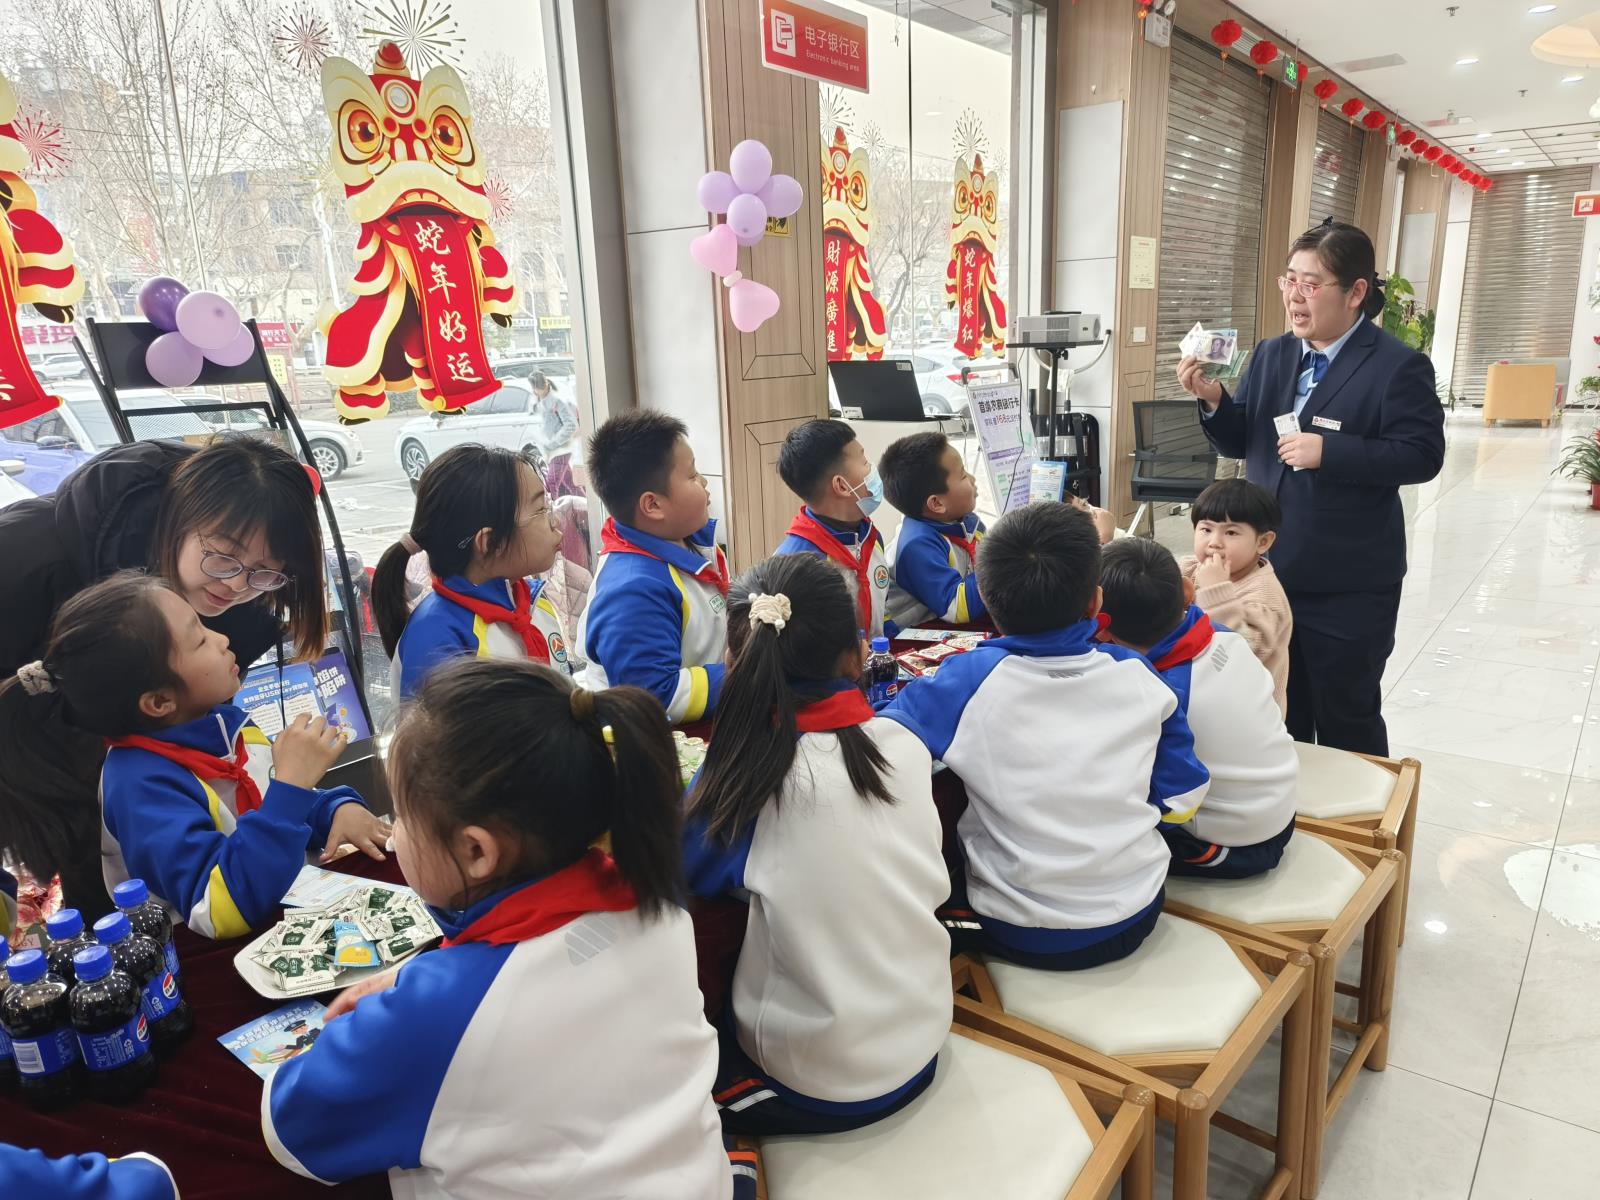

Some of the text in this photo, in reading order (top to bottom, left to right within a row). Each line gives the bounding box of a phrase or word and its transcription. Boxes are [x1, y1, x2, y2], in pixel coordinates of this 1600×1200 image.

[805, 25, 860, 59] 电子银行区
[806, 49, 830, 63] Electronic
[830, 57, 849, 71] banking
[415, 220, 483, 383] 蛇年好运
[962, 248, 976, 344] 蛇年爆红
